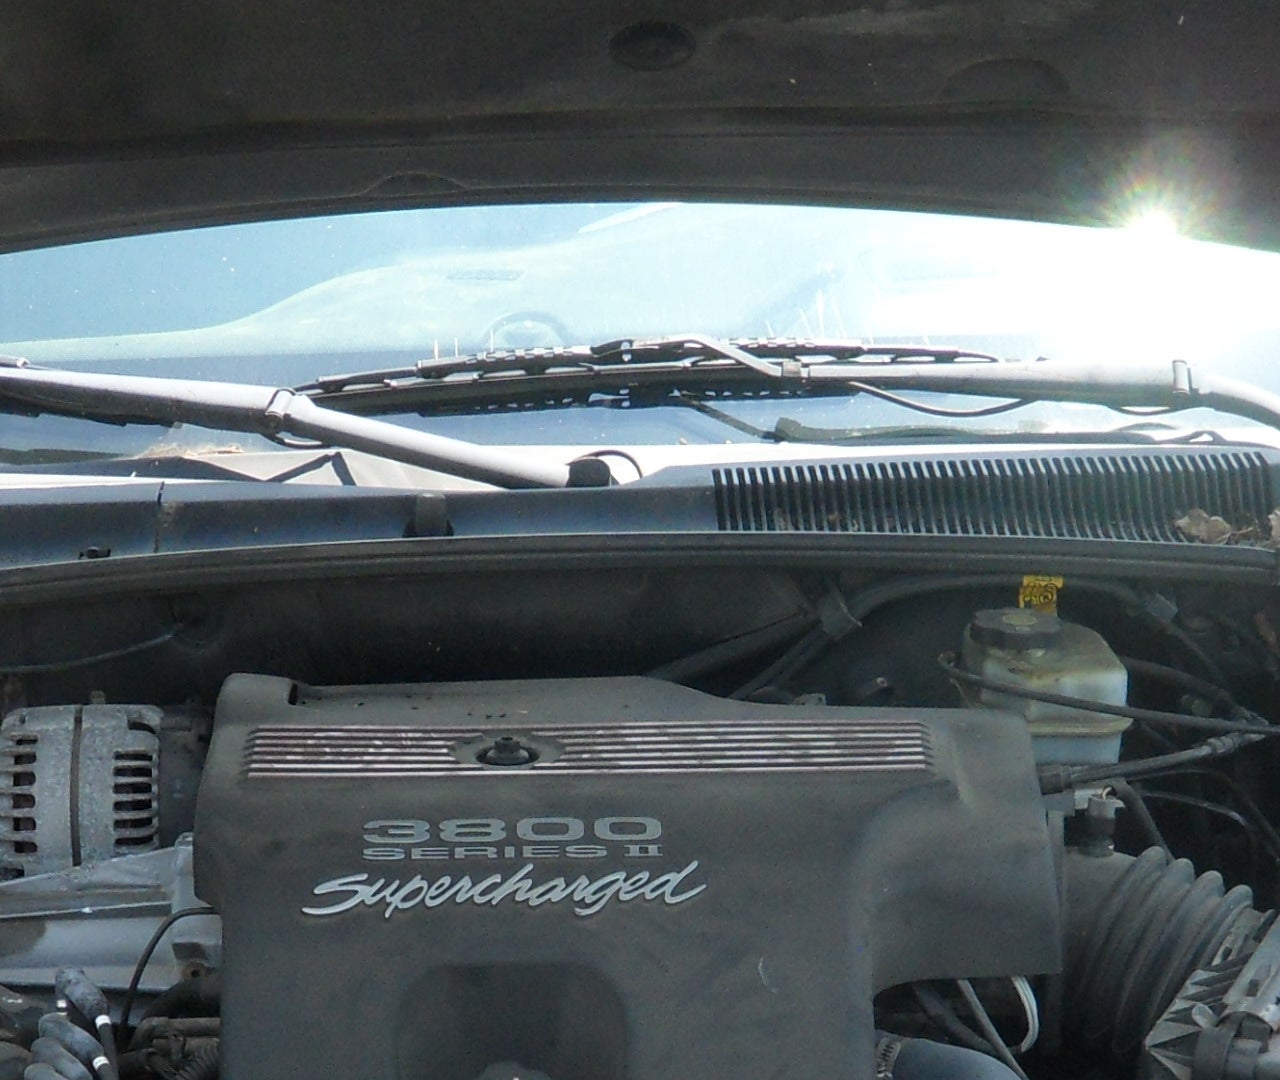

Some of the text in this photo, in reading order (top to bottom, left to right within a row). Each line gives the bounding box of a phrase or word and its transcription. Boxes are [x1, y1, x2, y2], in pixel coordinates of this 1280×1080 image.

[363, 816, 662, 844] 3800
[362, 844, 663, 861] SERIES II
[301, 859, 708, 919] Supercharged
